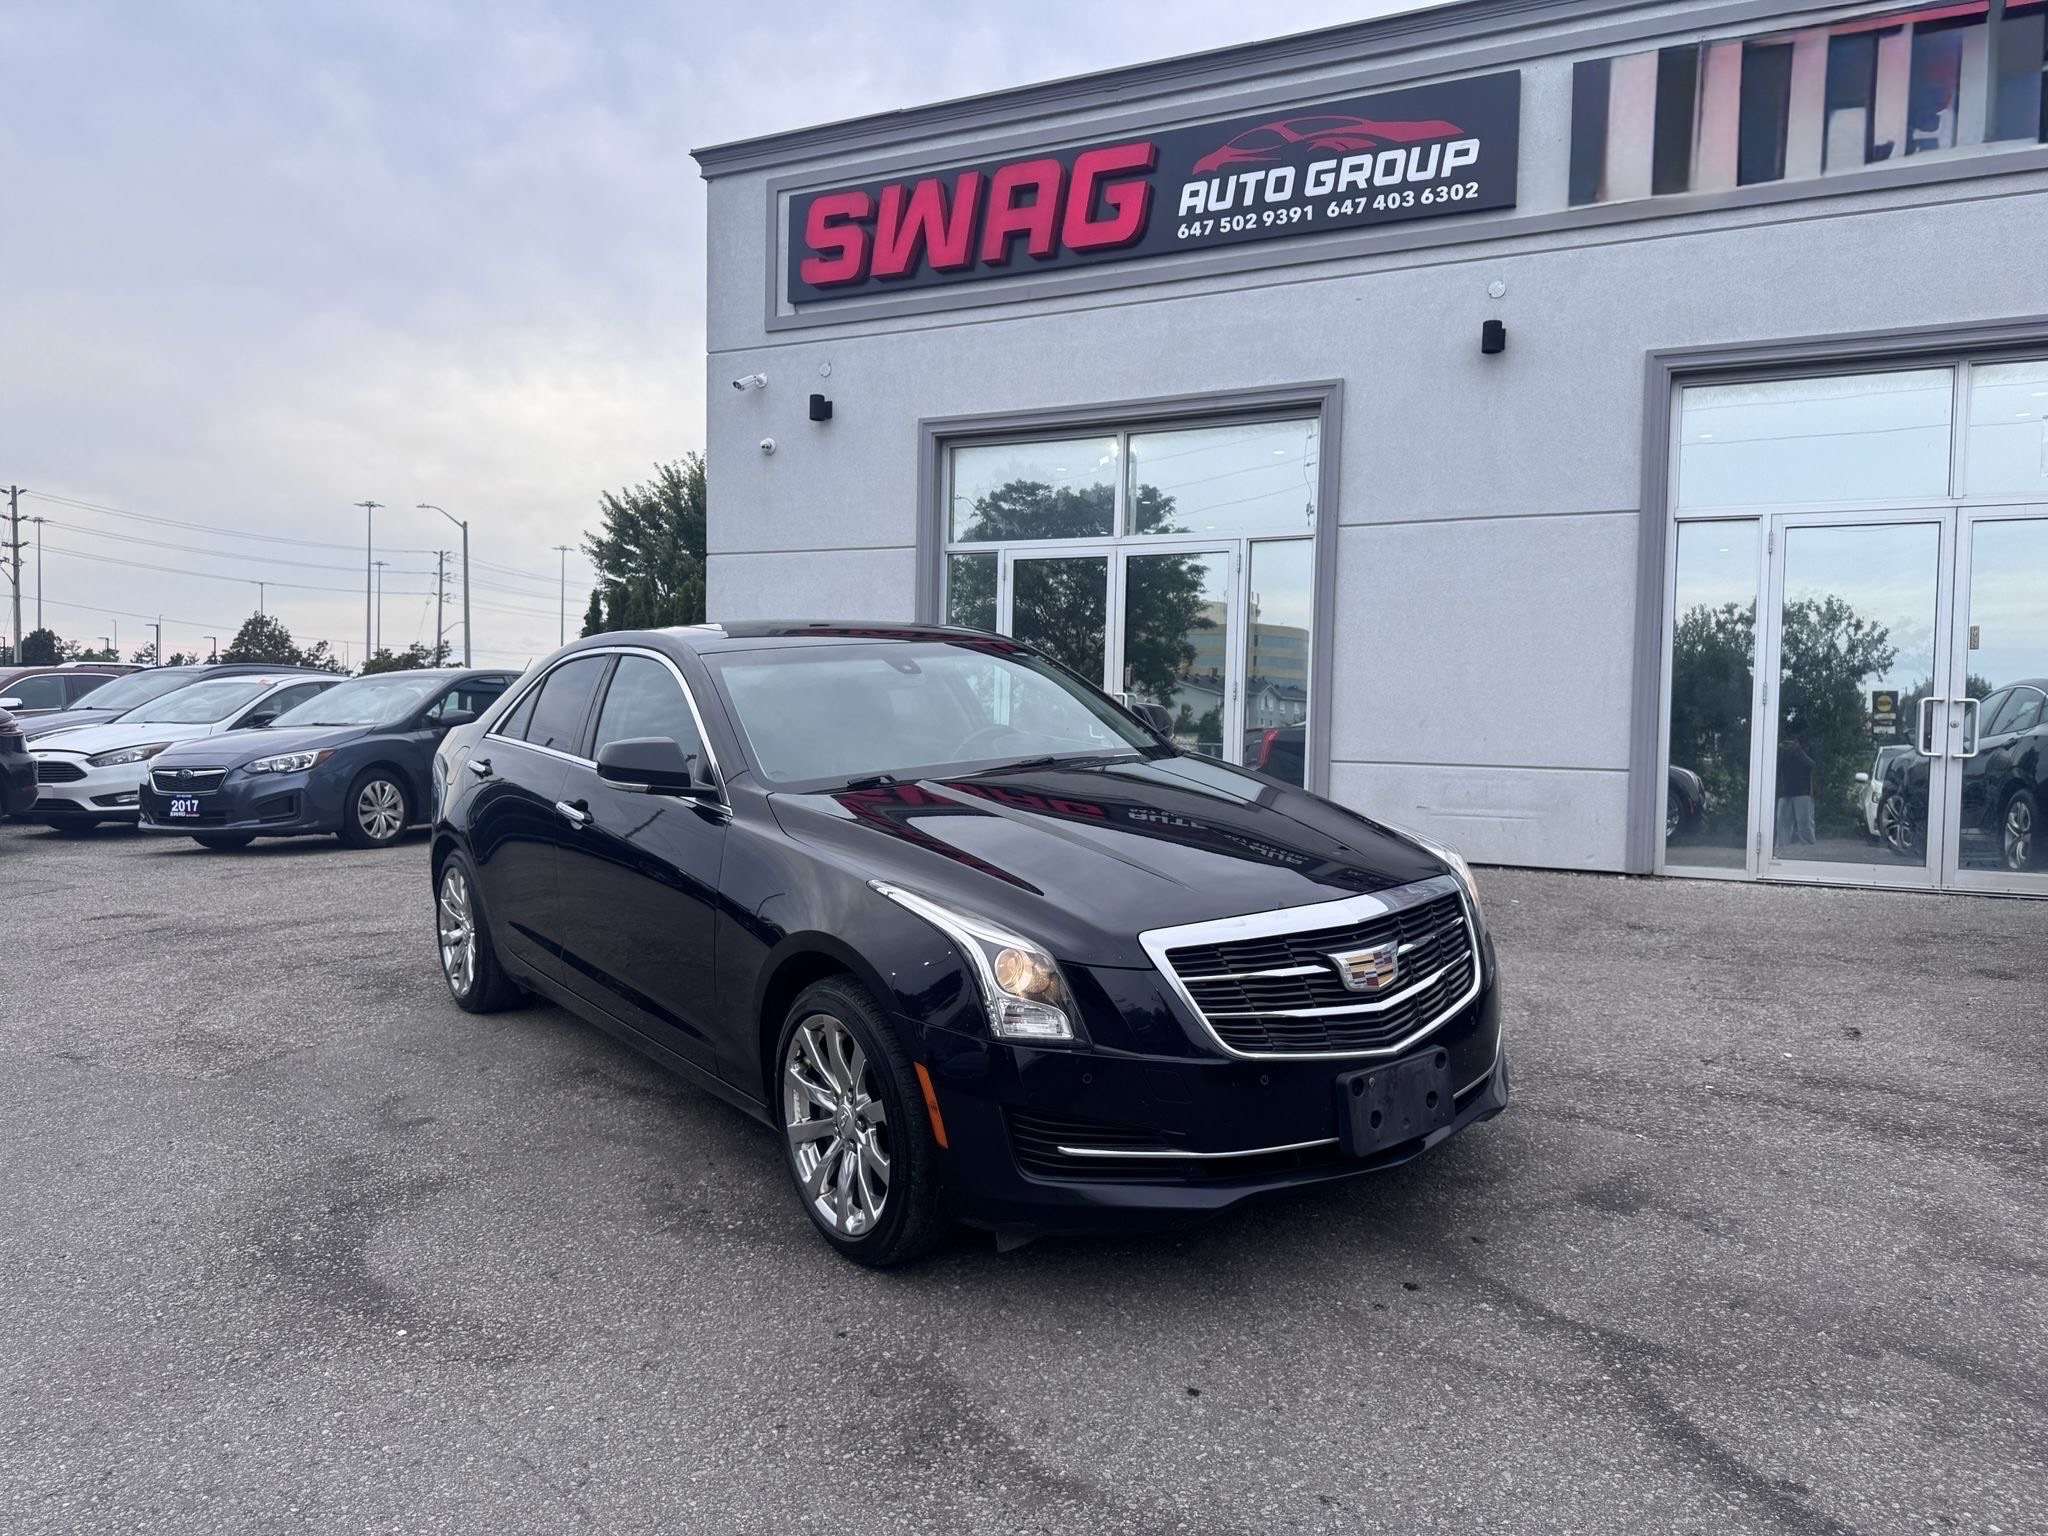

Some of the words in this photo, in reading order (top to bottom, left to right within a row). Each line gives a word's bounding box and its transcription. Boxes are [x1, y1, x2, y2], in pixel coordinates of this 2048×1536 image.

[1177, 219, 1214, 239] 647
[1219, 213, 1257, 233] 502
[1262, 205, 1313, 227] 9391
[1326, 197, 1367, 218] 647
[1372, 190, 1415, 211] 403
[1420, 181, 1479, 205] 6302
[1178, 166, 1296, 217] AUTO
[1304, 138, 1480, 197] GROUP
[801, 142, 1155, 288] SWAG
[171, 800, 199, 812] 2017
